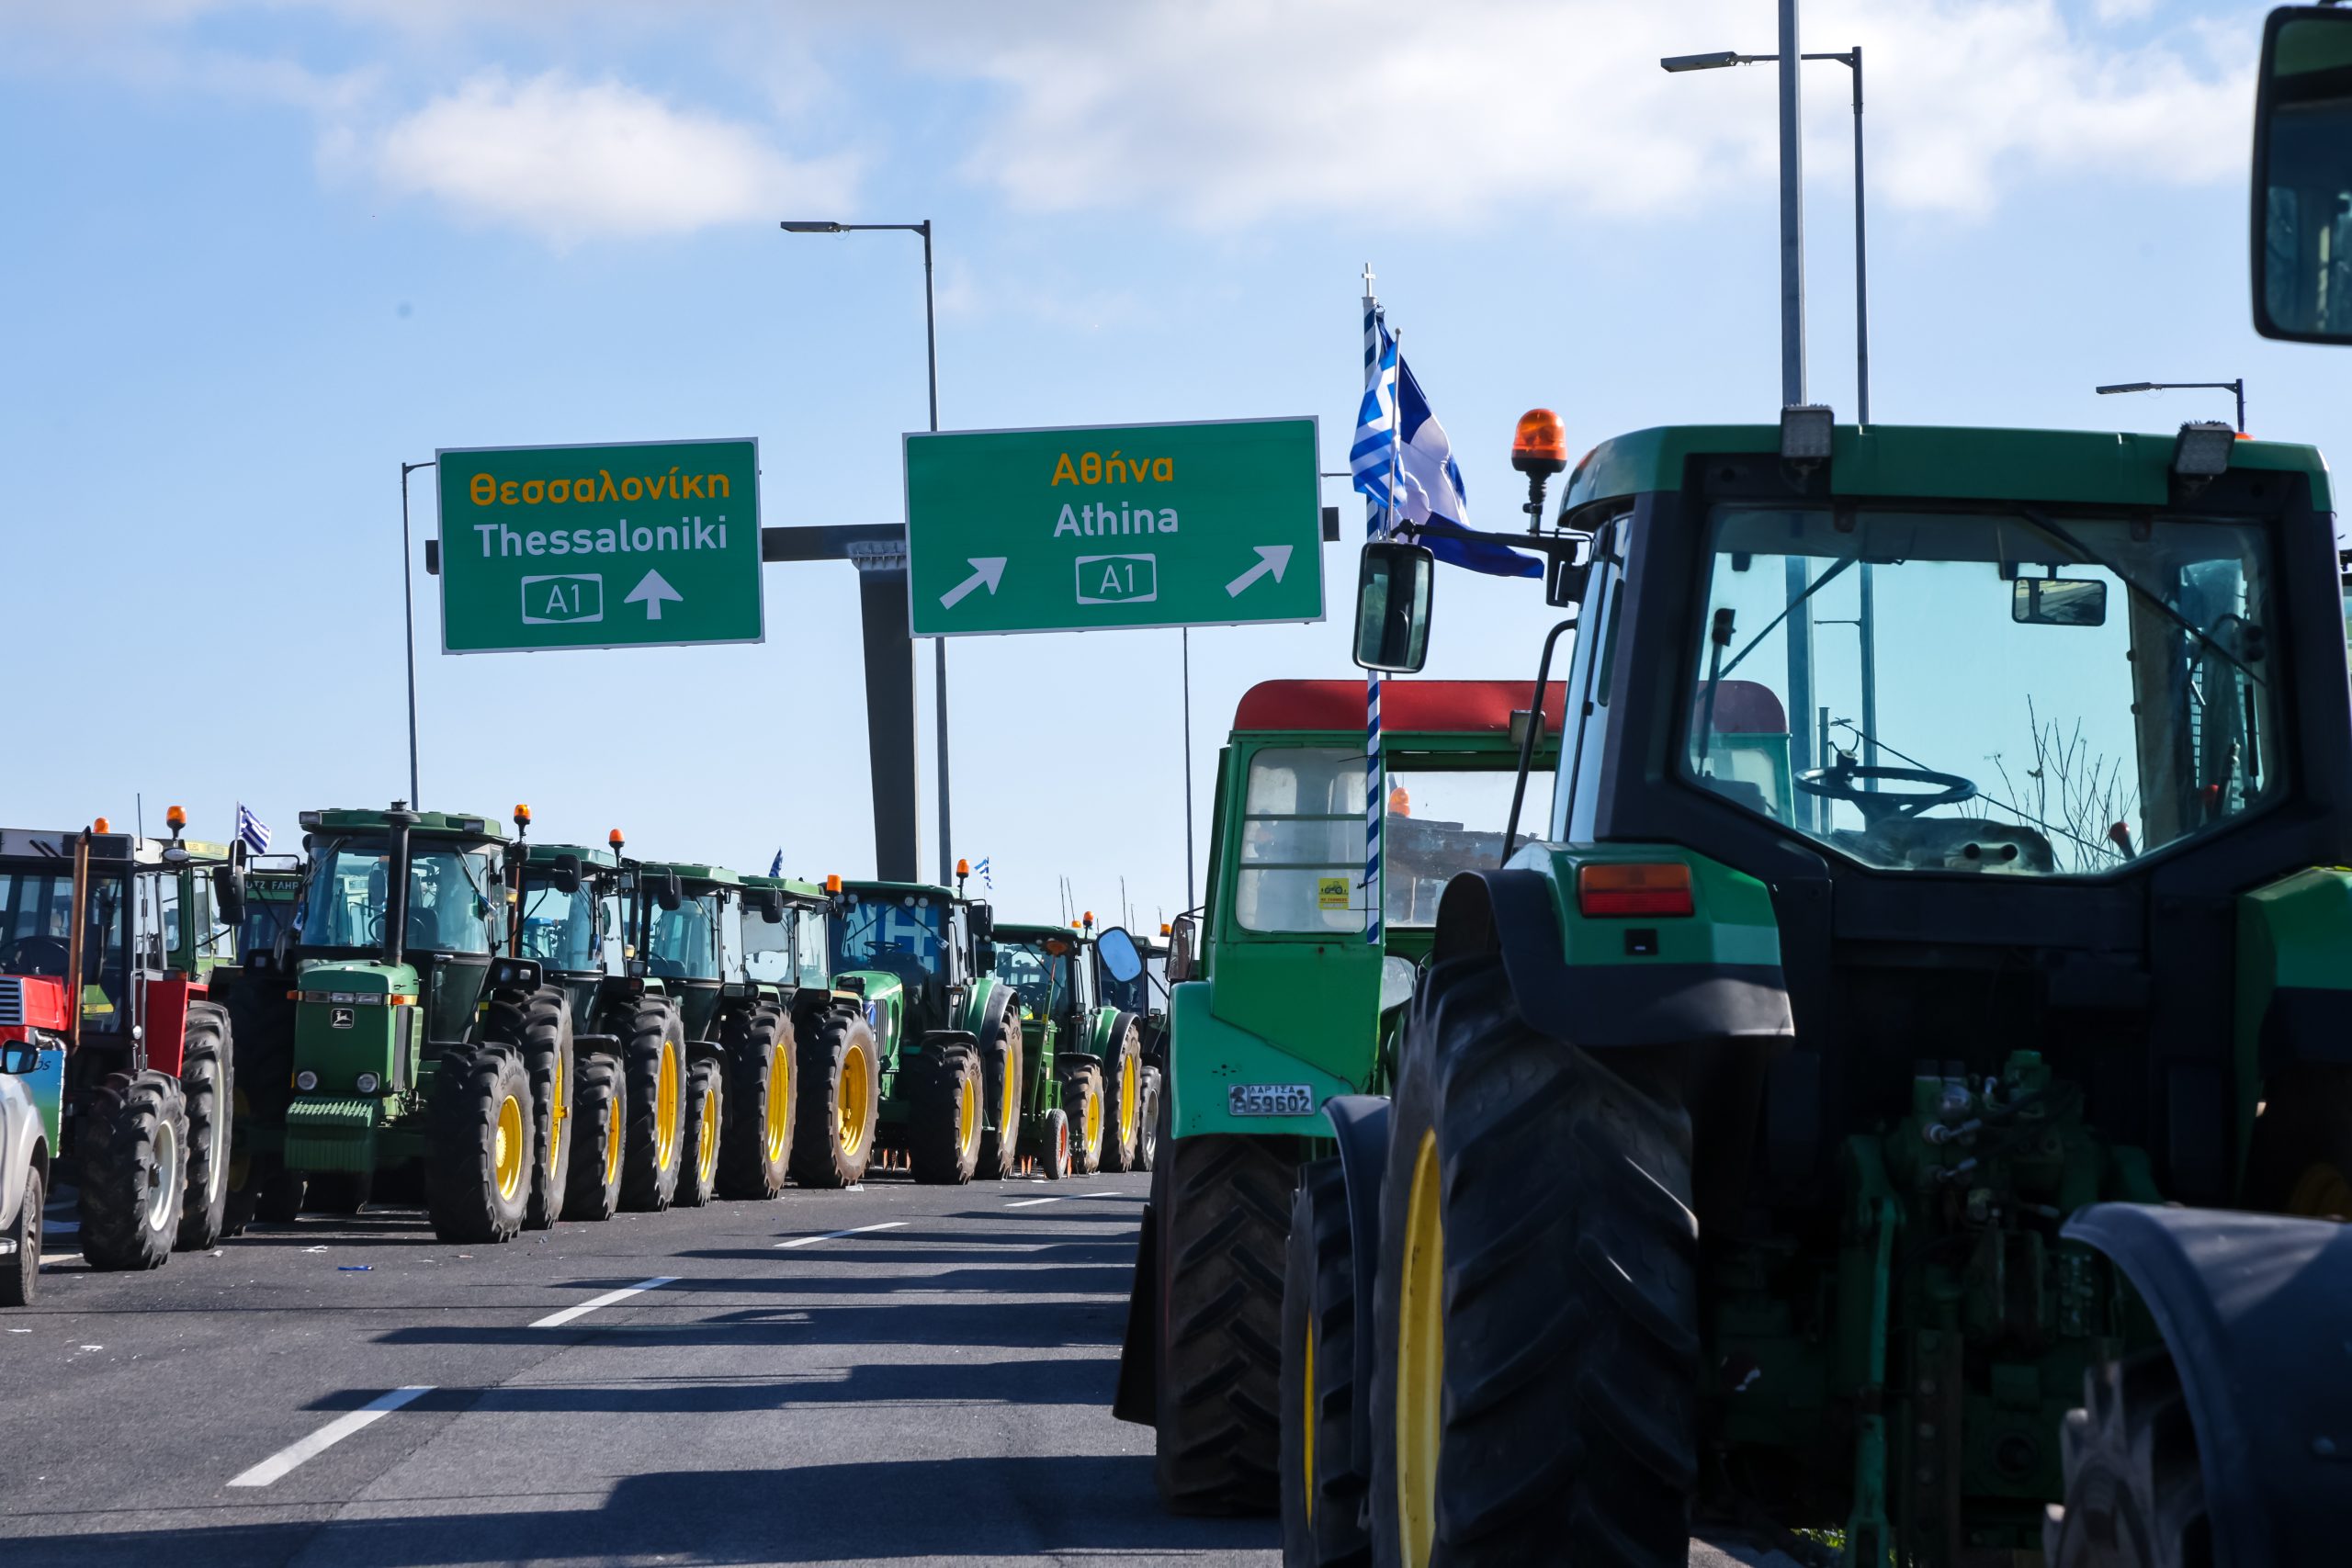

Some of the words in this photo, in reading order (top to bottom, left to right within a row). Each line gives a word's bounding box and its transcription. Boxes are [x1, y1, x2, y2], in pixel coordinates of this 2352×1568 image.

[1051, 450, 1173, 486] Αθήνα
[469, 466, 729, 506] Θεσσαλονίκη
[1053, 501, 1179, 537] Athina
[473, 514, 727, 558] Thessaloniki
[1099, 563, 1134, 594] A1
[545, 583, 580, 614] A1
[245, 880, 266, 889] UTZ
[1250, 1095, 1310, 1111] 59602
